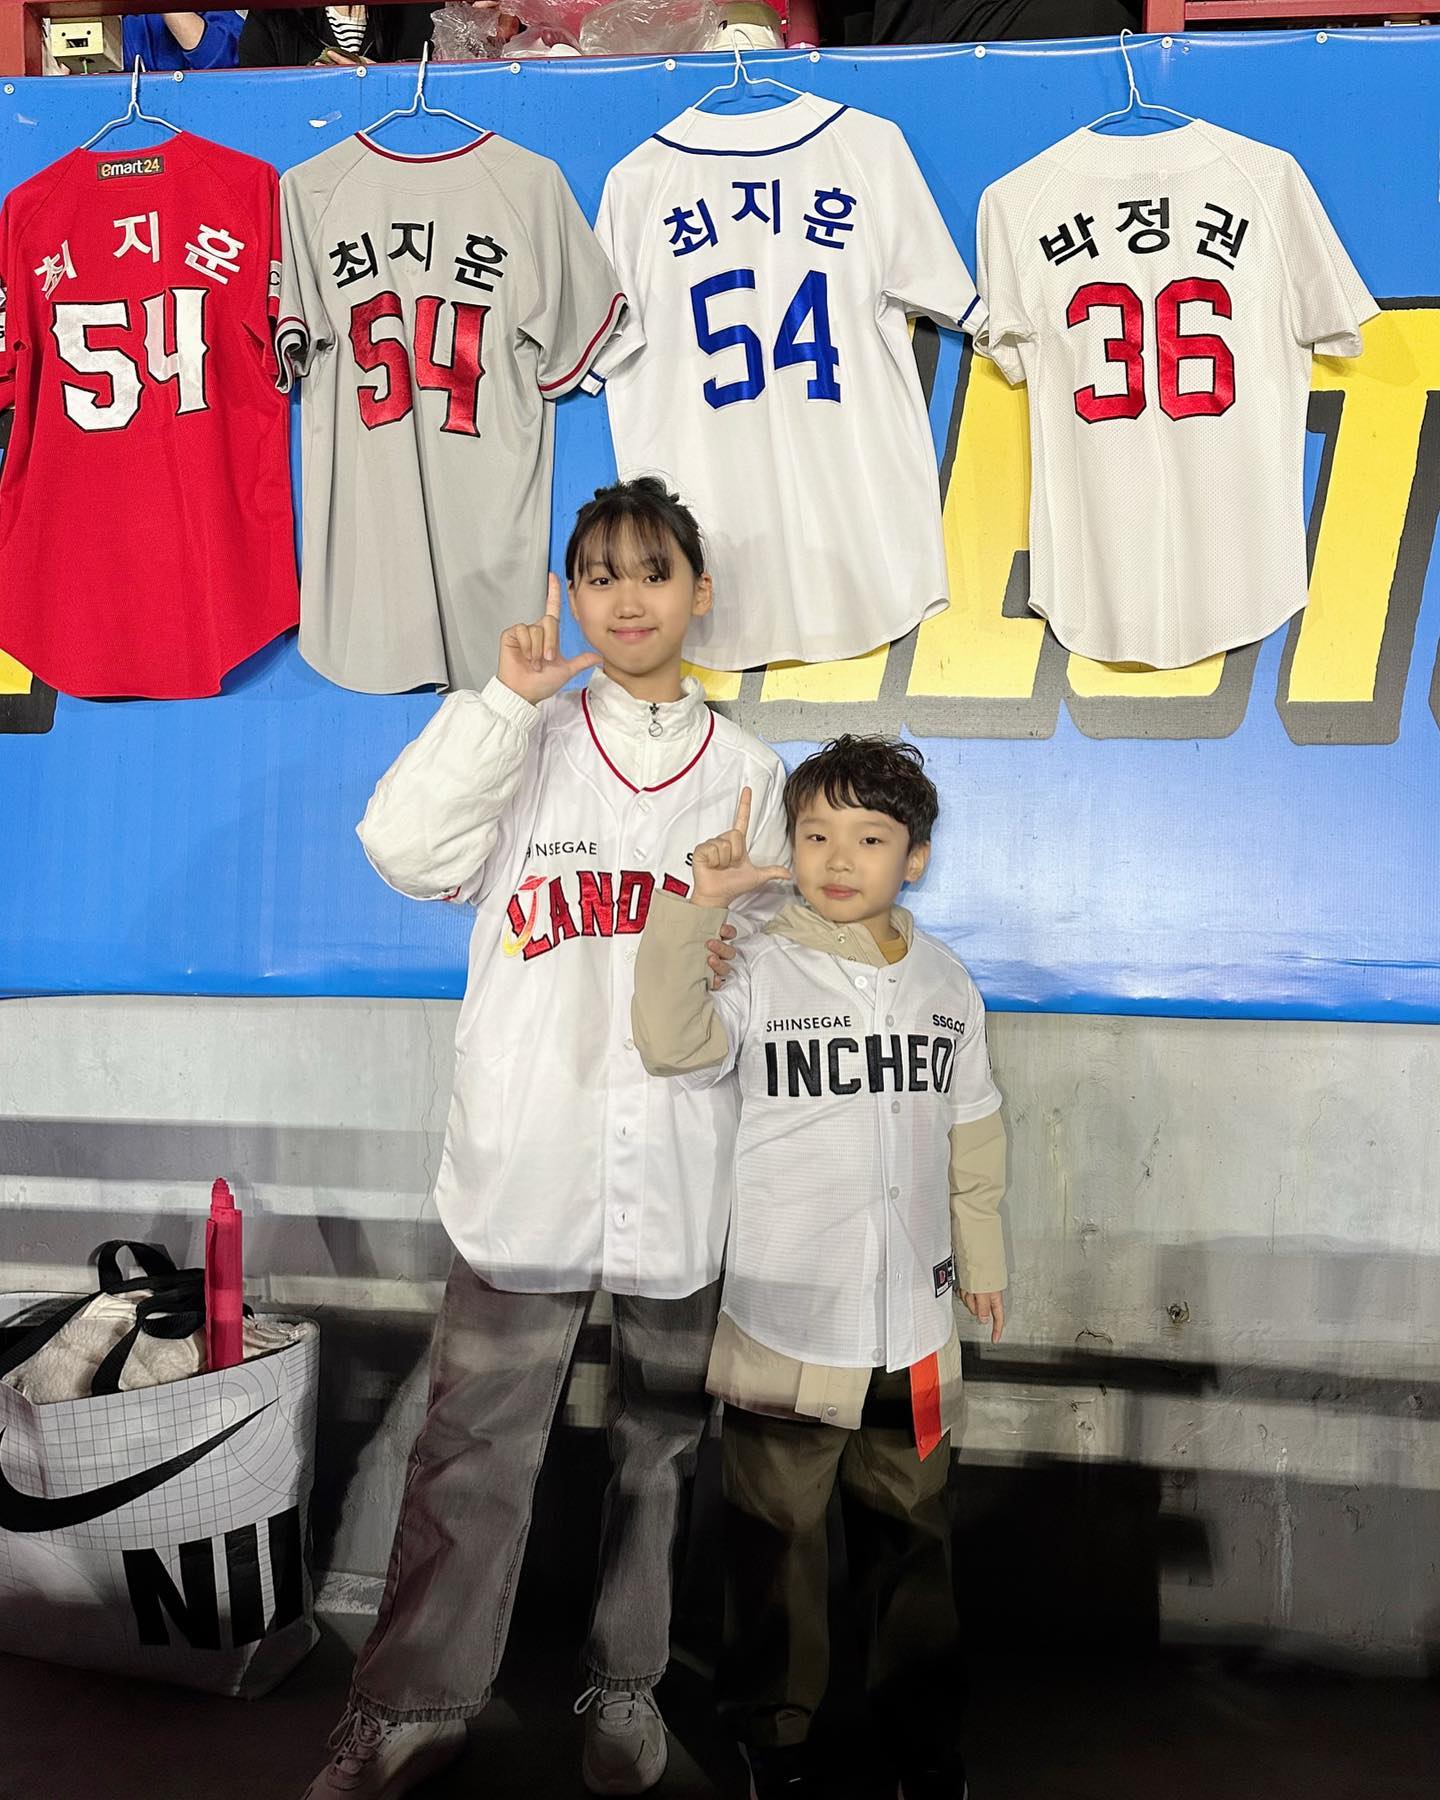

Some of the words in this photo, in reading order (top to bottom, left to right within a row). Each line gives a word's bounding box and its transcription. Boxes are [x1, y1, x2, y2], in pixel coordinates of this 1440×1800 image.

[102, 158, 160, 177] emart24
[50, 287, 210, 433] 54
[348, 291, 491, 438] 54
[690, 268, 841, 409] 54
[1066, 277, 1236, 424] 36
[766, 1015, 852, 1032] SHINSEGAE
